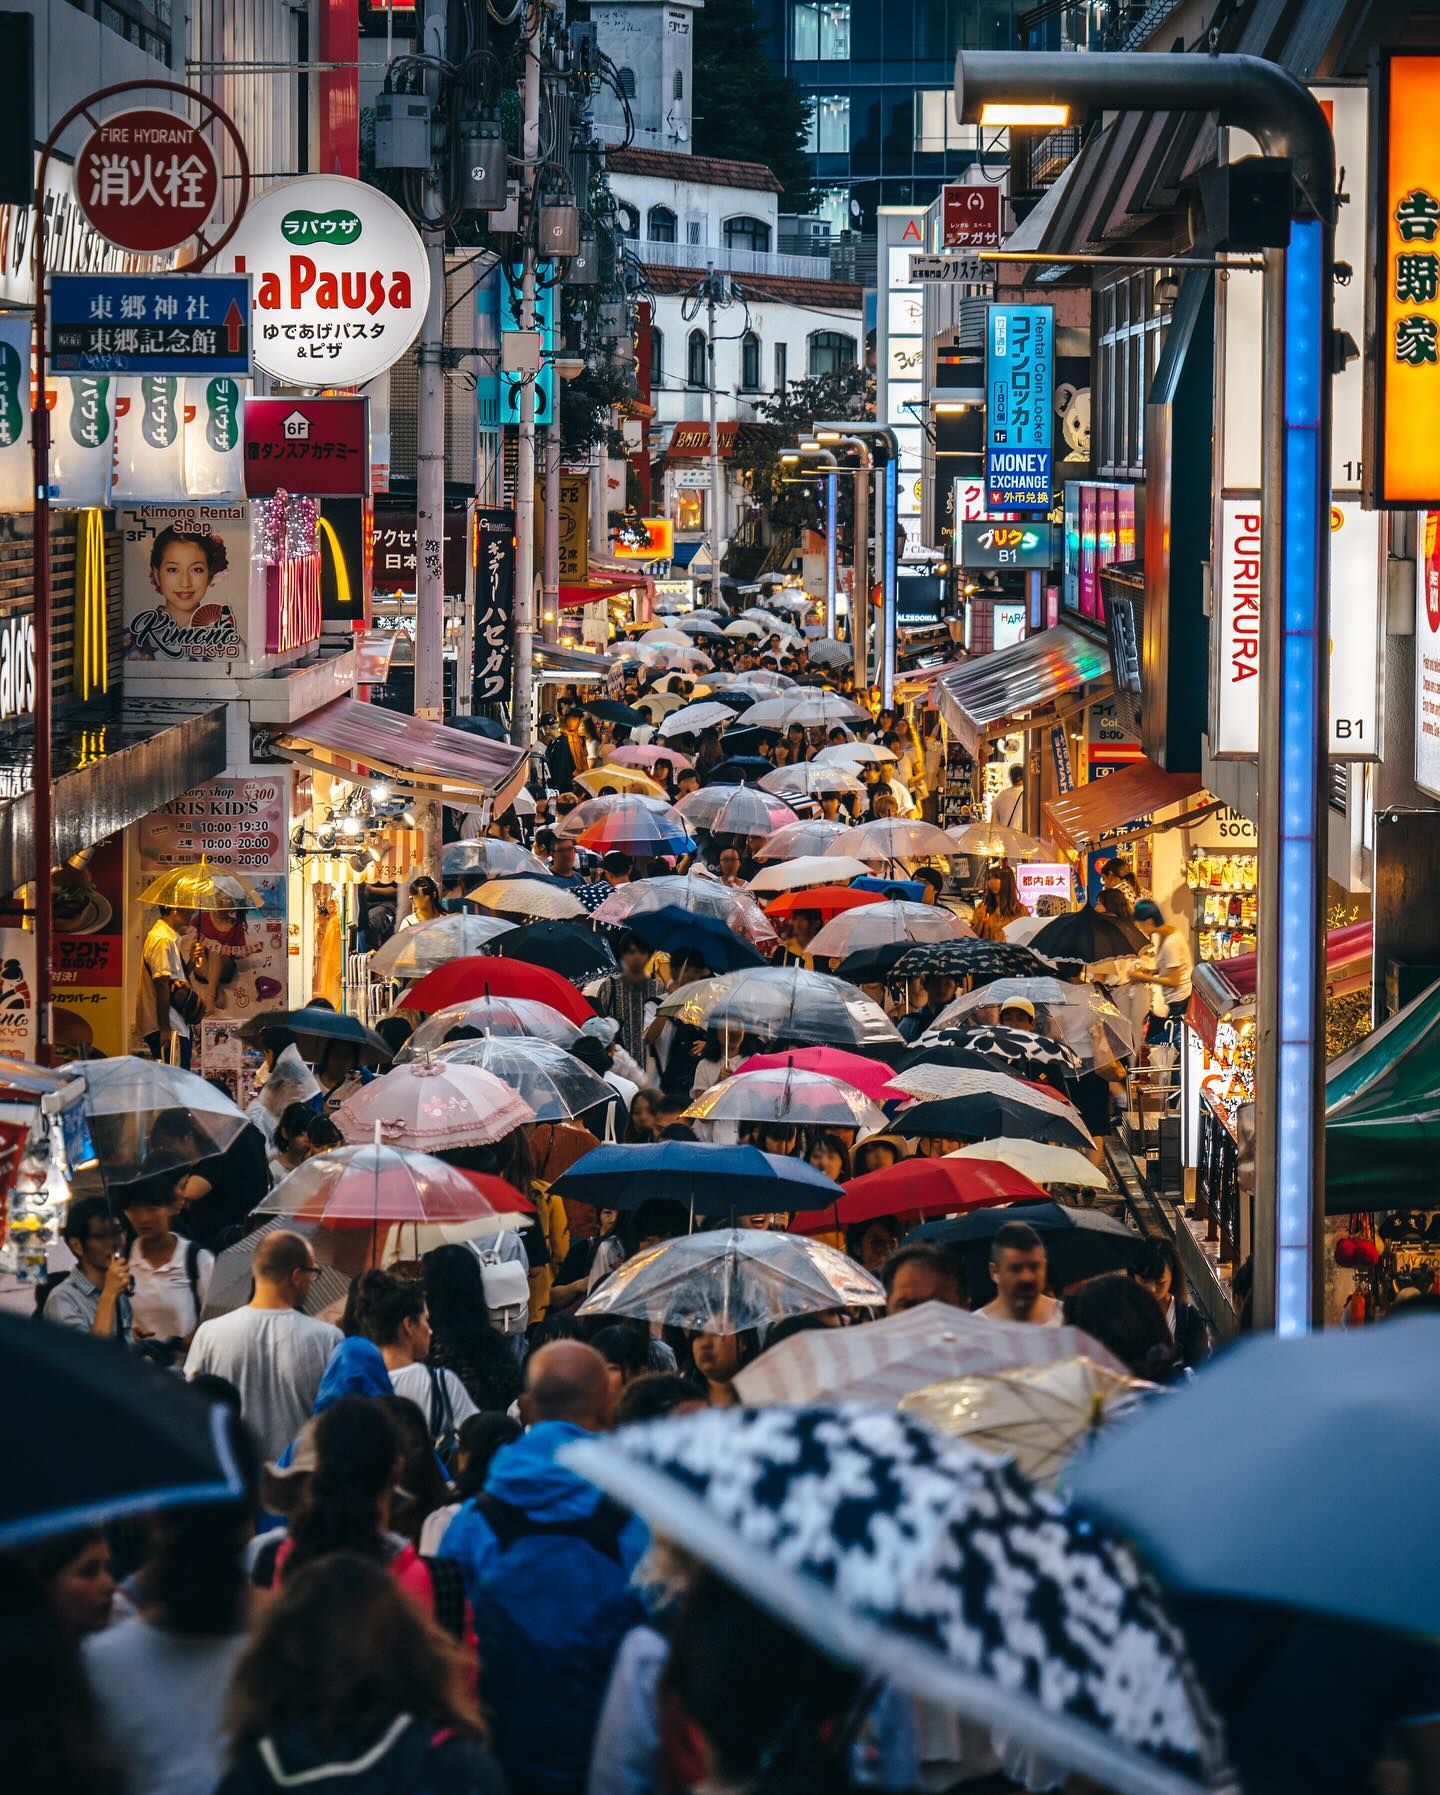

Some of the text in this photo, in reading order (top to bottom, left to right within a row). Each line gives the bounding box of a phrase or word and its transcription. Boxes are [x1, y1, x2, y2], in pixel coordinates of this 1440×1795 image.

[101, 128, 195, 144] FIRE HYDRANT
[89, 153, 208, 208] 消火栓
[283, 218, 360, 236] ラパウザ
[289, 255, 412, 316] Pausa
[88, 294, 211, 321] 東郷神社
[263, 323, 385, 340] ゆであげパスタ
[88, 327, 217, 354] 東郷記念館
[297, 343, 343, 359] &ピザ
[1012, 316, 1031, 444] コインロッカー
[1034, 316, 1047, 445] Rental Coin Locker
[215, 380, 230, 450] ラパウザ
[287, 423, 306, 435] 6F
[996, 432, 1006, 442] 1F
[991, 454, 1048, 472] MONEY
[990, 475, 1049, 489] EXCHANGE
[141, 506, 245, 520] Kimono Rental
[126, 531, 146, 541] 3F
[174, 520, 211, 536] Shop
[999, 549, 1016, 563] B1
[1231, 514, 1260, 683] PURIKURA
[130, 609, 240, 658] Kimono
[181, 646, 240, 657] TOKYO
[476, 607, 510, 699] ハセガワ
[1092, 704, 1117, 715] コイ
[1336, 719, 1364, 739] B1
[208, 787, 235, 800] shop
[152, 801, 259, 816] ARIS KID'S
[1022, 875, 1066, 887] 都内最大
